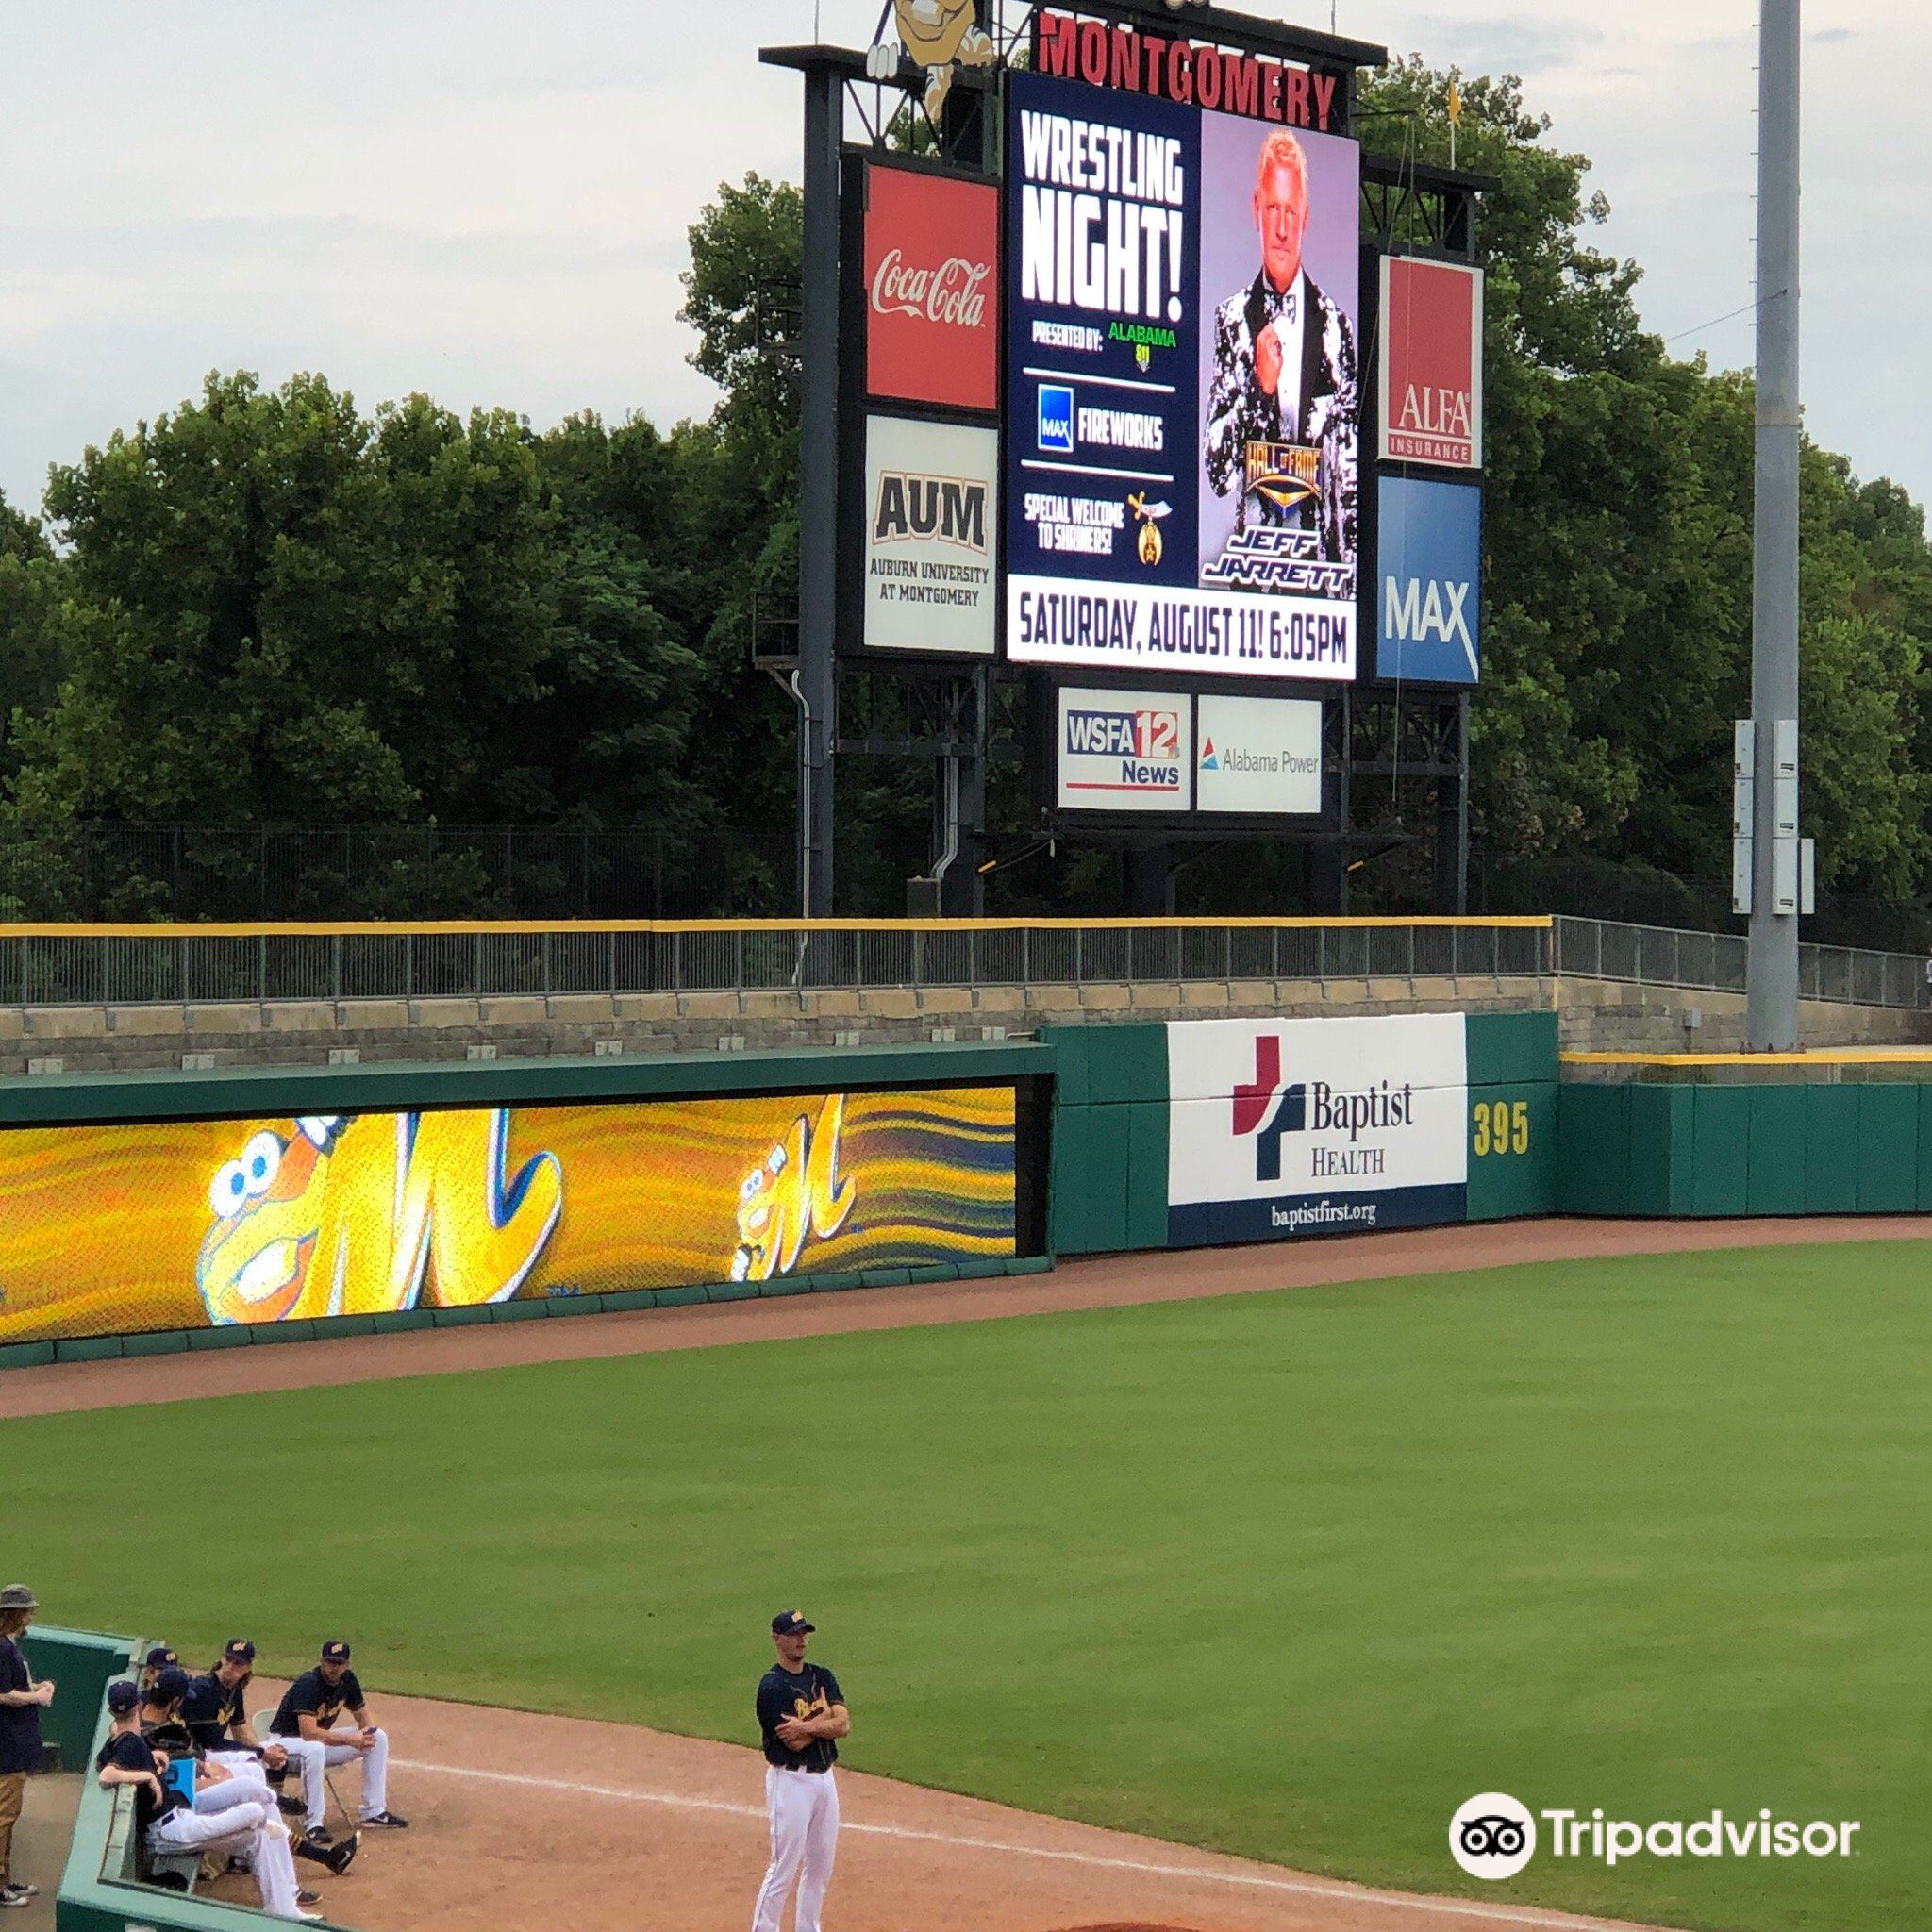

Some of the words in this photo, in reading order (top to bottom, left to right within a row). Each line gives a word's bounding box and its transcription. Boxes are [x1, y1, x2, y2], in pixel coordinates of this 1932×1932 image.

[1039, 9, 1336, 131] MONTGOMERY
[1021, 109, 1183, 206] WRESTLING
[1022, 184, 1182, 322] NIGHT!
[872, 249, 991, 327] Coca-Cola
[1032, 320, 1085, 349] PRESENTED
[1086, 326, 1103, 352] BY:
[1108, 322, 1177, 348] ALABAMA
[1077, 407, 1164, 450] FIREWORKS
[1399, 383, 1472, 437] ALFA
[1041, 417, 1072, 448] MAX
[1391, 437, 1469, 462] INSURANCE
[1247, 441, 1280, 485] HALL
[1289, 448, 1320, 485] FAME
[872, 469, 990, 555] AUM
[1024, 493, 1071, 524] SPECIAL
[1071, 497, 1124, 528] WELCOME
[1038, 521, 1053, 549] TO
[1054, 524, 1113, 554] SHRINERS!
[1227, 526, 1321, 557] JEFF
[870, 558, 919, 579] AUBURN
[921, 562, 990, 584] UNIVERSITY
[1201, 553, 1353, 591] JARRETT
[879, 583, 896, 600] AT
[899, 584, 979, 607] MONTGOMERY
[1020, 591, 1141, 655] SATURDAY,
[1148, 601, 1231, 657] AUGUST
[1238, 608, 1264, 658] 11!
[1269, 610, 1347, 664] 6:05PM
[1385, 575, 1479, 683] MAX
[1068, 715, 1135, 754] WSFA
[1136, 711, 1178, 758] 12
[1122, 759, 1179, 785] News
[1223, 748, 1278, 773] Alabama
[1282, 751, 1318, 774] Power
[1311, 1080, 1413, 1142] Baptist
[1474, 1101, 1529, 1157] 395
[1311, 1147, 1385, 1177] HEALTH
[1271, 1199, 1377, 1231] baptistfirst.org
